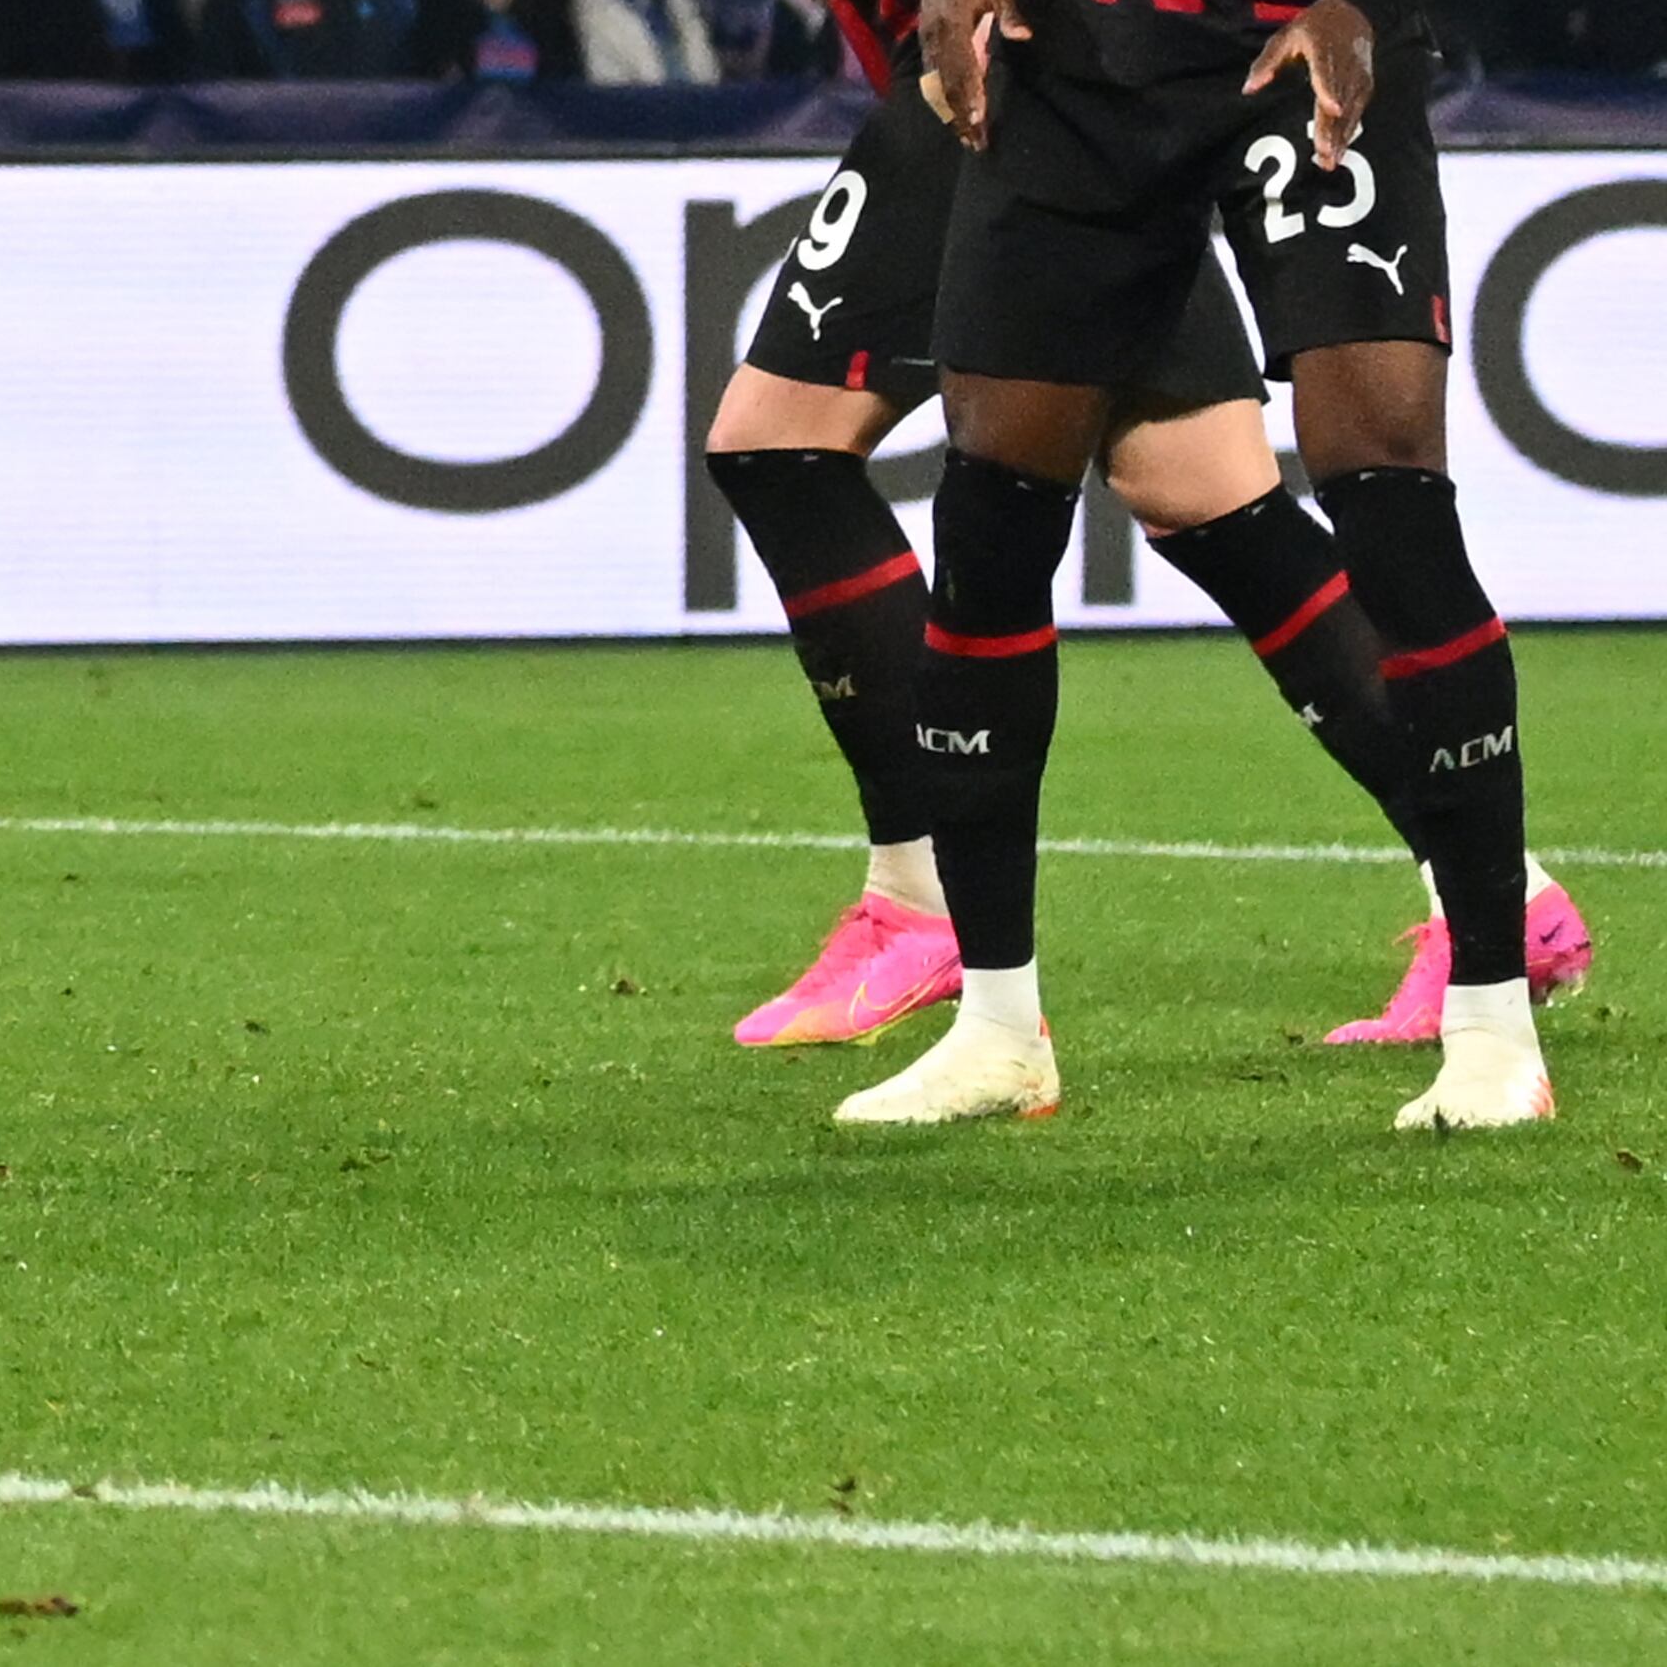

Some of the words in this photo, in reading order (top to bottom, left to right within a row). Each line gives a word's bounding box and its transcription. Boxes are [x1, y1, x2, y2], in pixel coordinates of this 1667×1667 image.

[785, 170, 868, 271] 9
[282, 176, 1667, 614] opo
[1429, 725, 1513, 773] ACM
